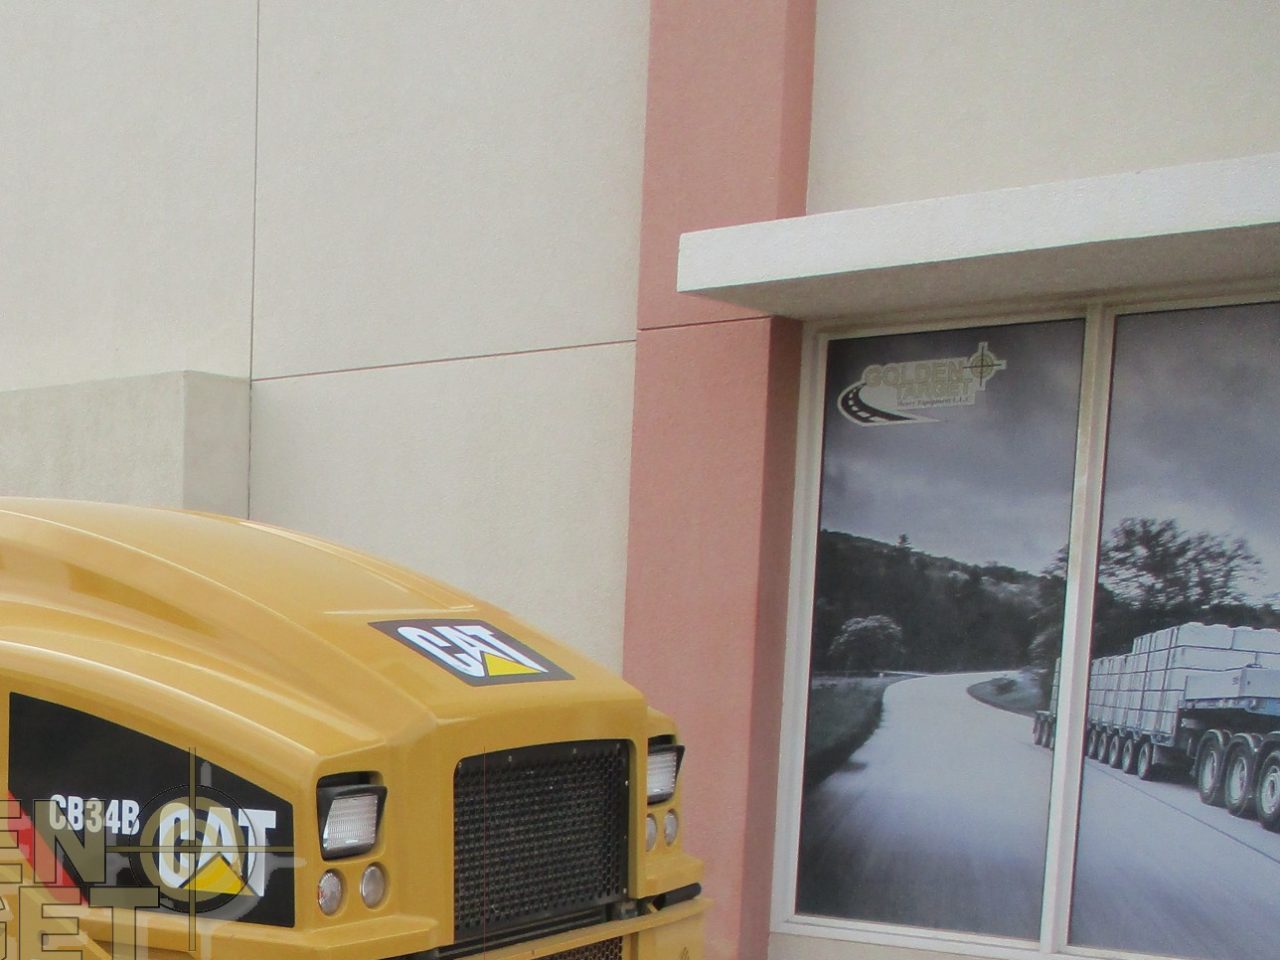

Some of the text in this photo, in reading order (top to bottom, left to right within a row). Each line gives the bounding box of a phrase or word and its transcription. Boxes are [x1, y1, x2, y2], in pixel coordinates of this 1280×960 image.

[864, 360, 967, 387] GOLDEN
[897, 380, 972, 399] TARGET
[397, 625, 549, 677] CAT
[48, 794, 141, 836] CB34B
[158, 801, 277, 897] CAT
